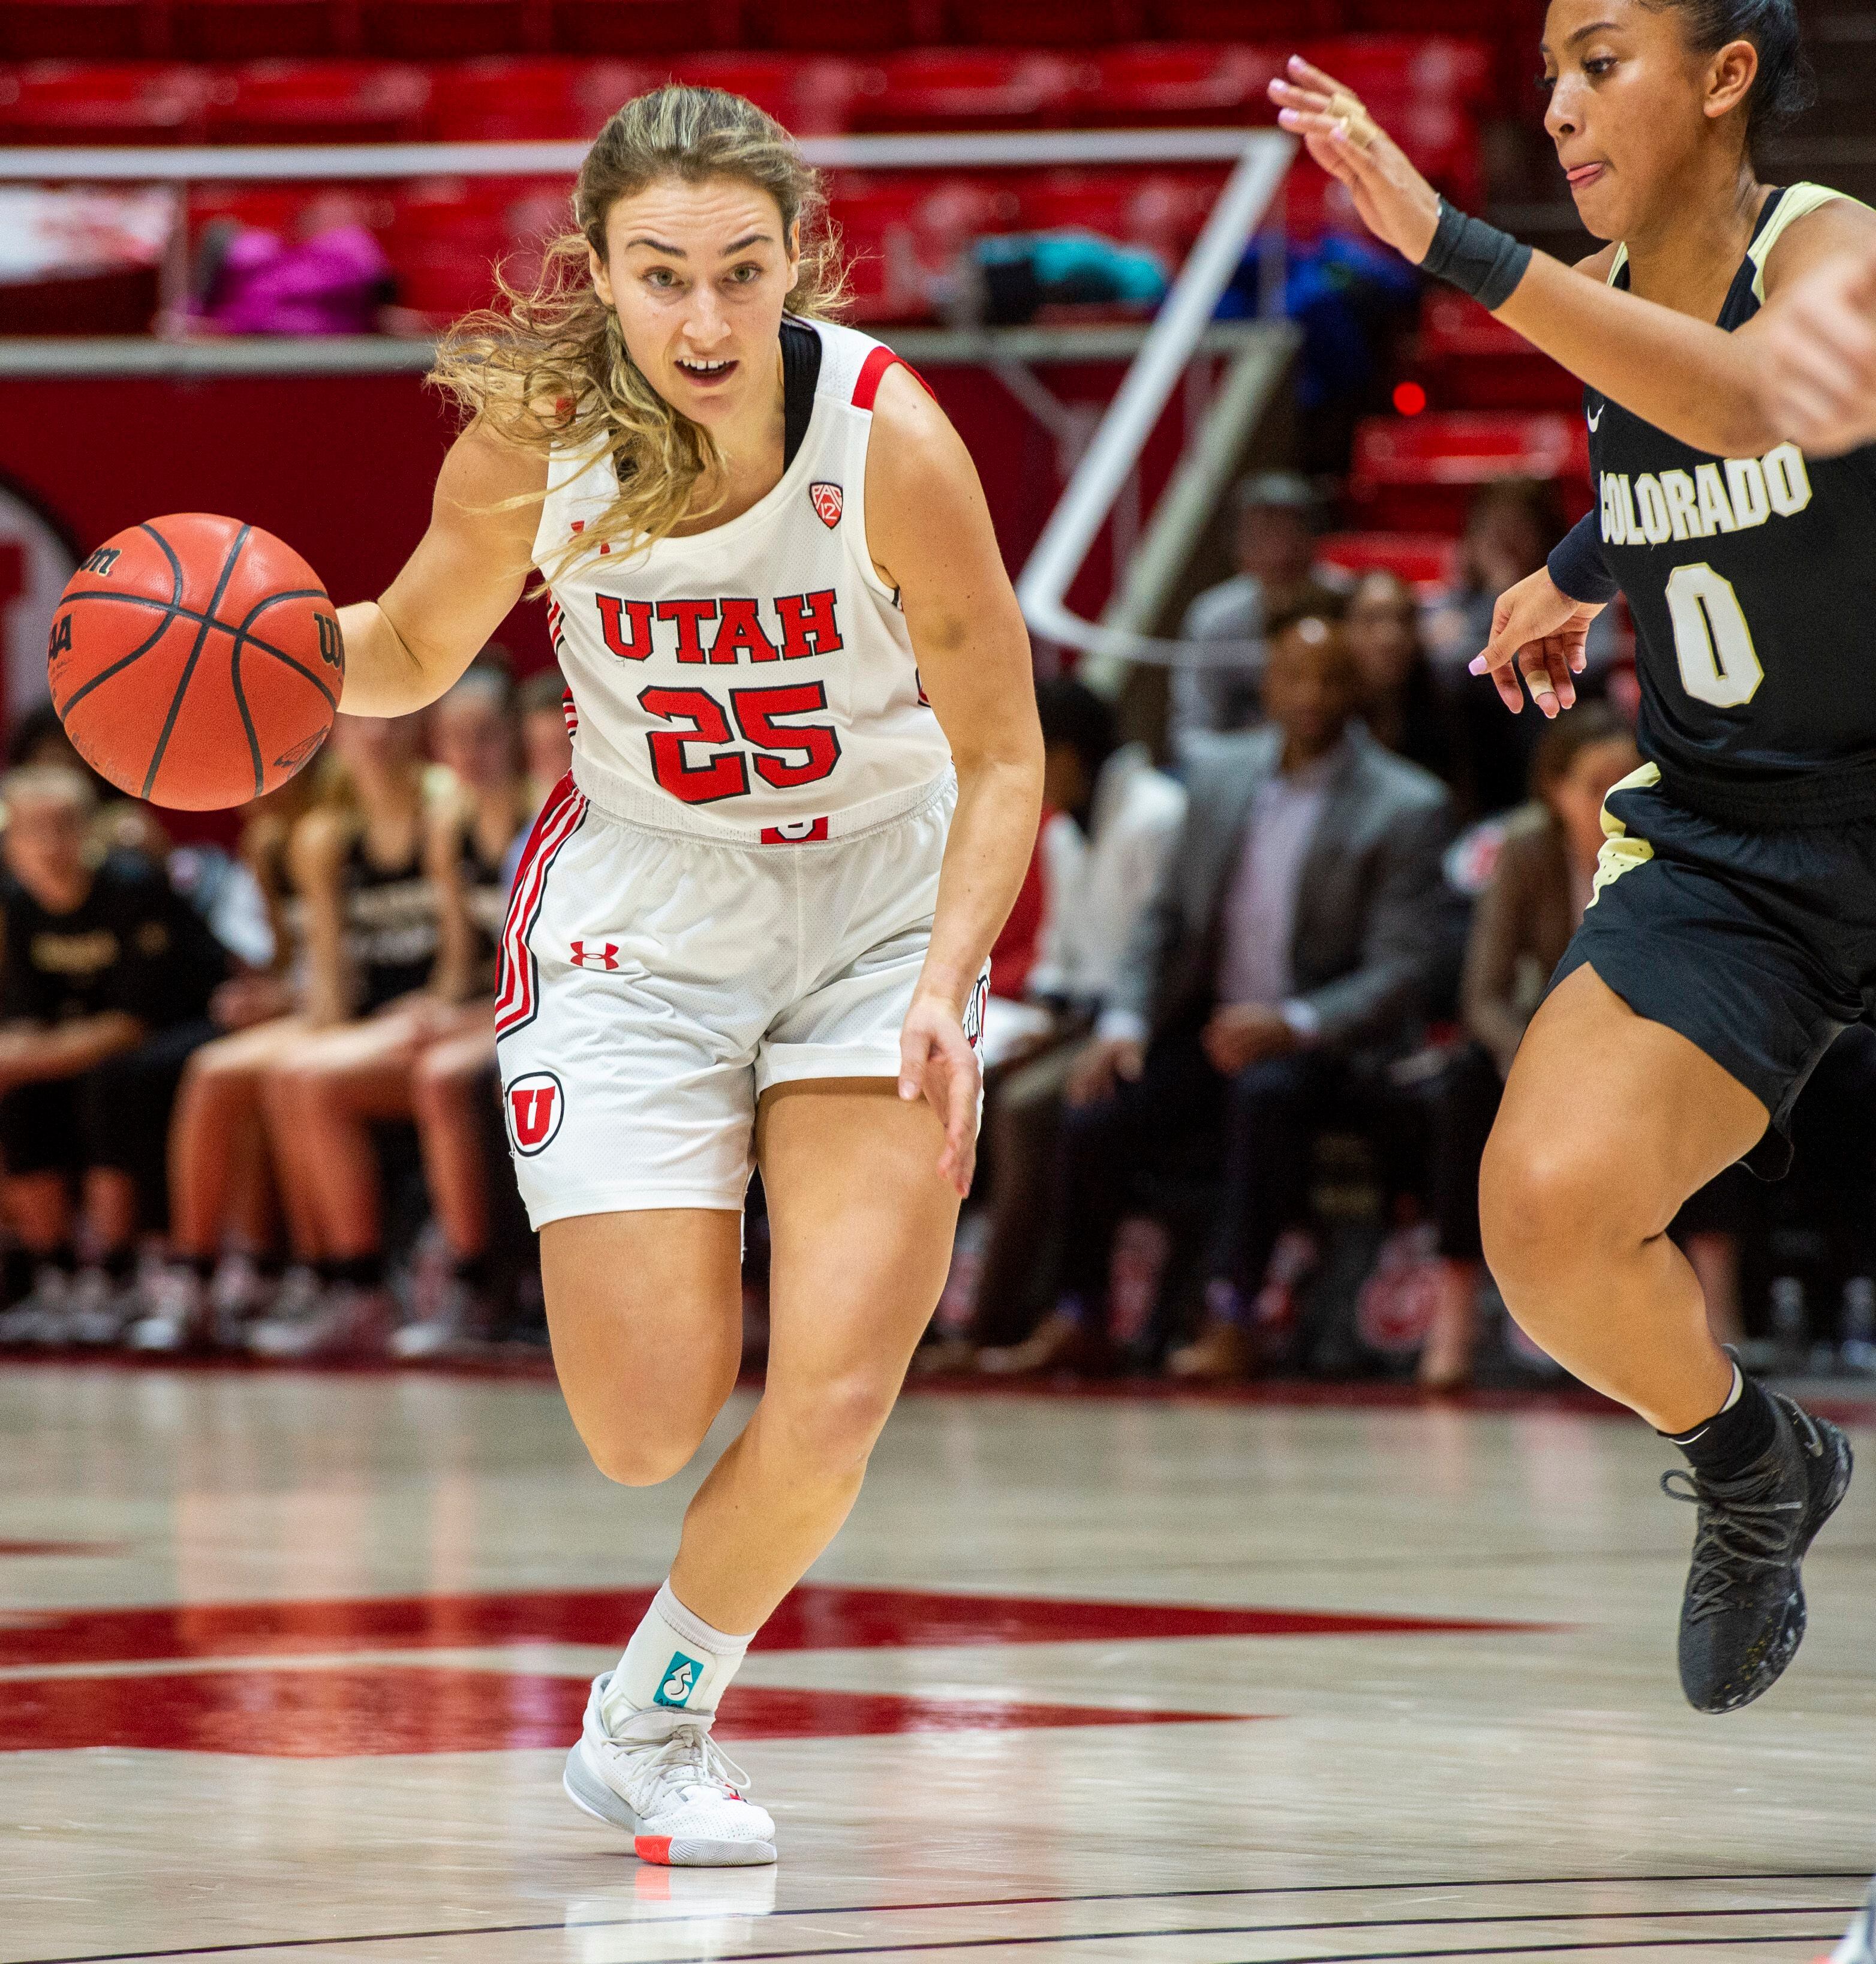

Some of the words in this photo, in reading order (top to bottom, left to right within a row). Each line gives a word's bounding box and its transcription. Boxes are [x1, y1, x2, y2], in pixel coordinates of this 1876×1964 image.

[811, 484, 842, 512] PAC
[820, 503, 837, 519] 12
[1600, 441, 1812, 545] COLORADO
[49, 614, 73, 660] AA
[596, 588, 844, 664] UTAH
[1666, 562, 1764, 708] 0
[637, 680, 842, 806] 25
[512, 1086, 555, 1146] U
